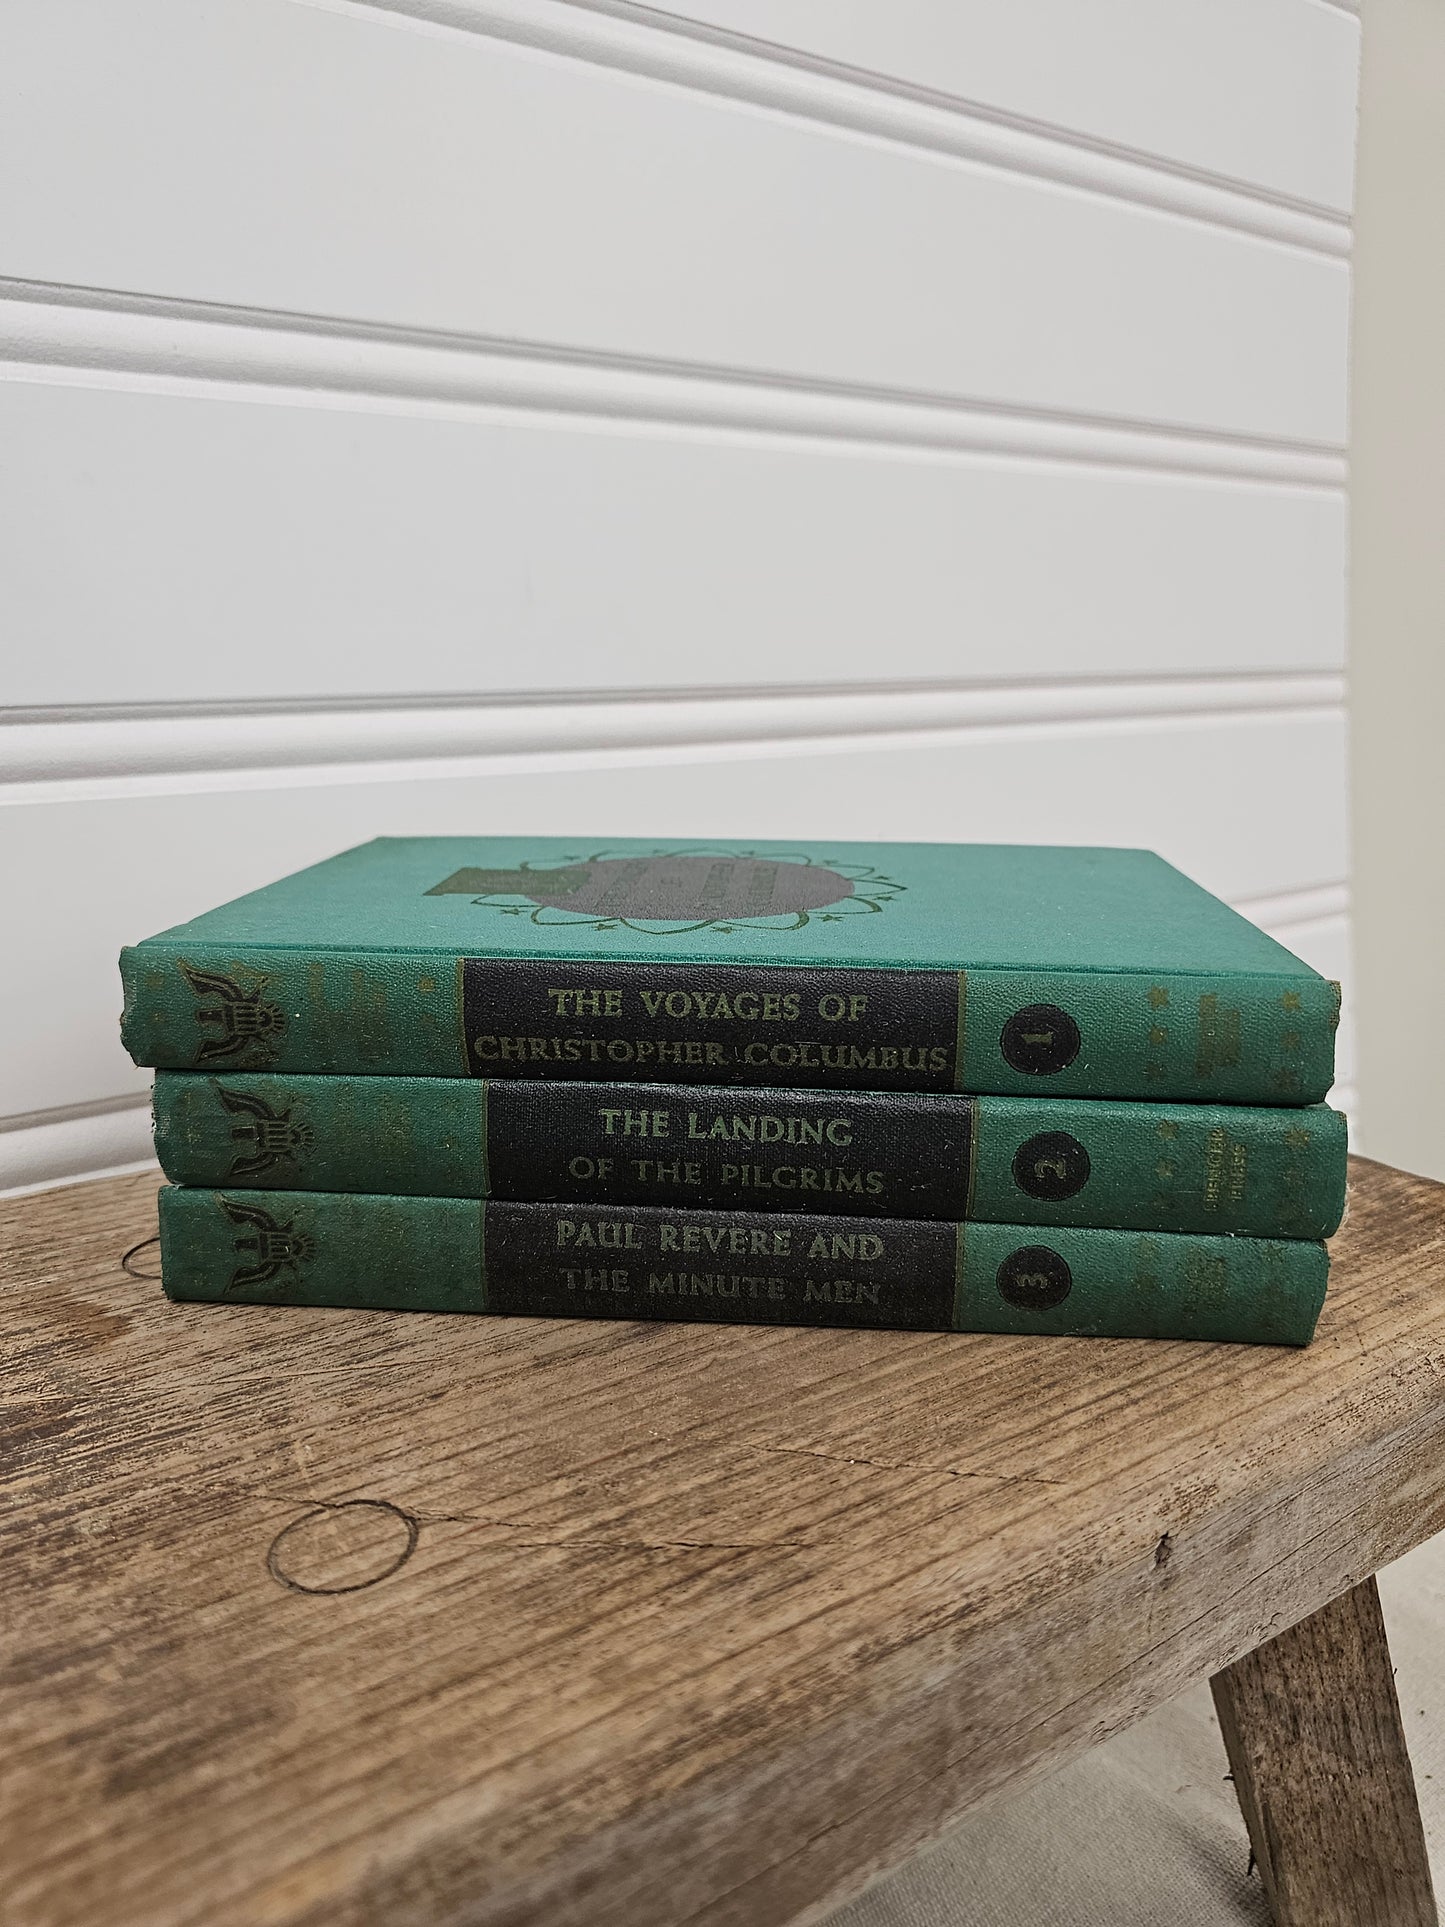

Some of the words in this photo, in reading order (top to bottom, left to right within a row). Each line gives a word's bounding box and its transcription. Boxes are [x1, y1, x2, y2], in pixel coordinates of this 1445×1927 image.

[548, 988, 622, 1018] THE
[641, 989, 801, 1021] VOYAGES
[818, 994, 870, 1022] OF
[473, 1035, 729, 1067] CHRISTOPHER
[744, 1041, 949, 1073] COLUMBUS
[1021, 1032, 1054, 1049] 1
[599, 1109, 670, 1139] THE
[688, 1113, 854, 1148] LANDING
[568, 1156, 615, 1181] OF
[631, 1160, 702, 1186] THE
[720, 1164, 885, 1195] PILGRIMS
[1033, 1157, 1067, 1180] 2
[556, 1219, 644, 1250] PAUL
[659, 1224, 791, 1257] REVERE
[808, 1232, 885, 1262] AND
[560, 1267, 631, 1293] THE
[647, 1274, 787, 1303] MINUTE
[803, 1279, 882, 1306] MEN
[1015, 1274, 1049, 1290] 3
